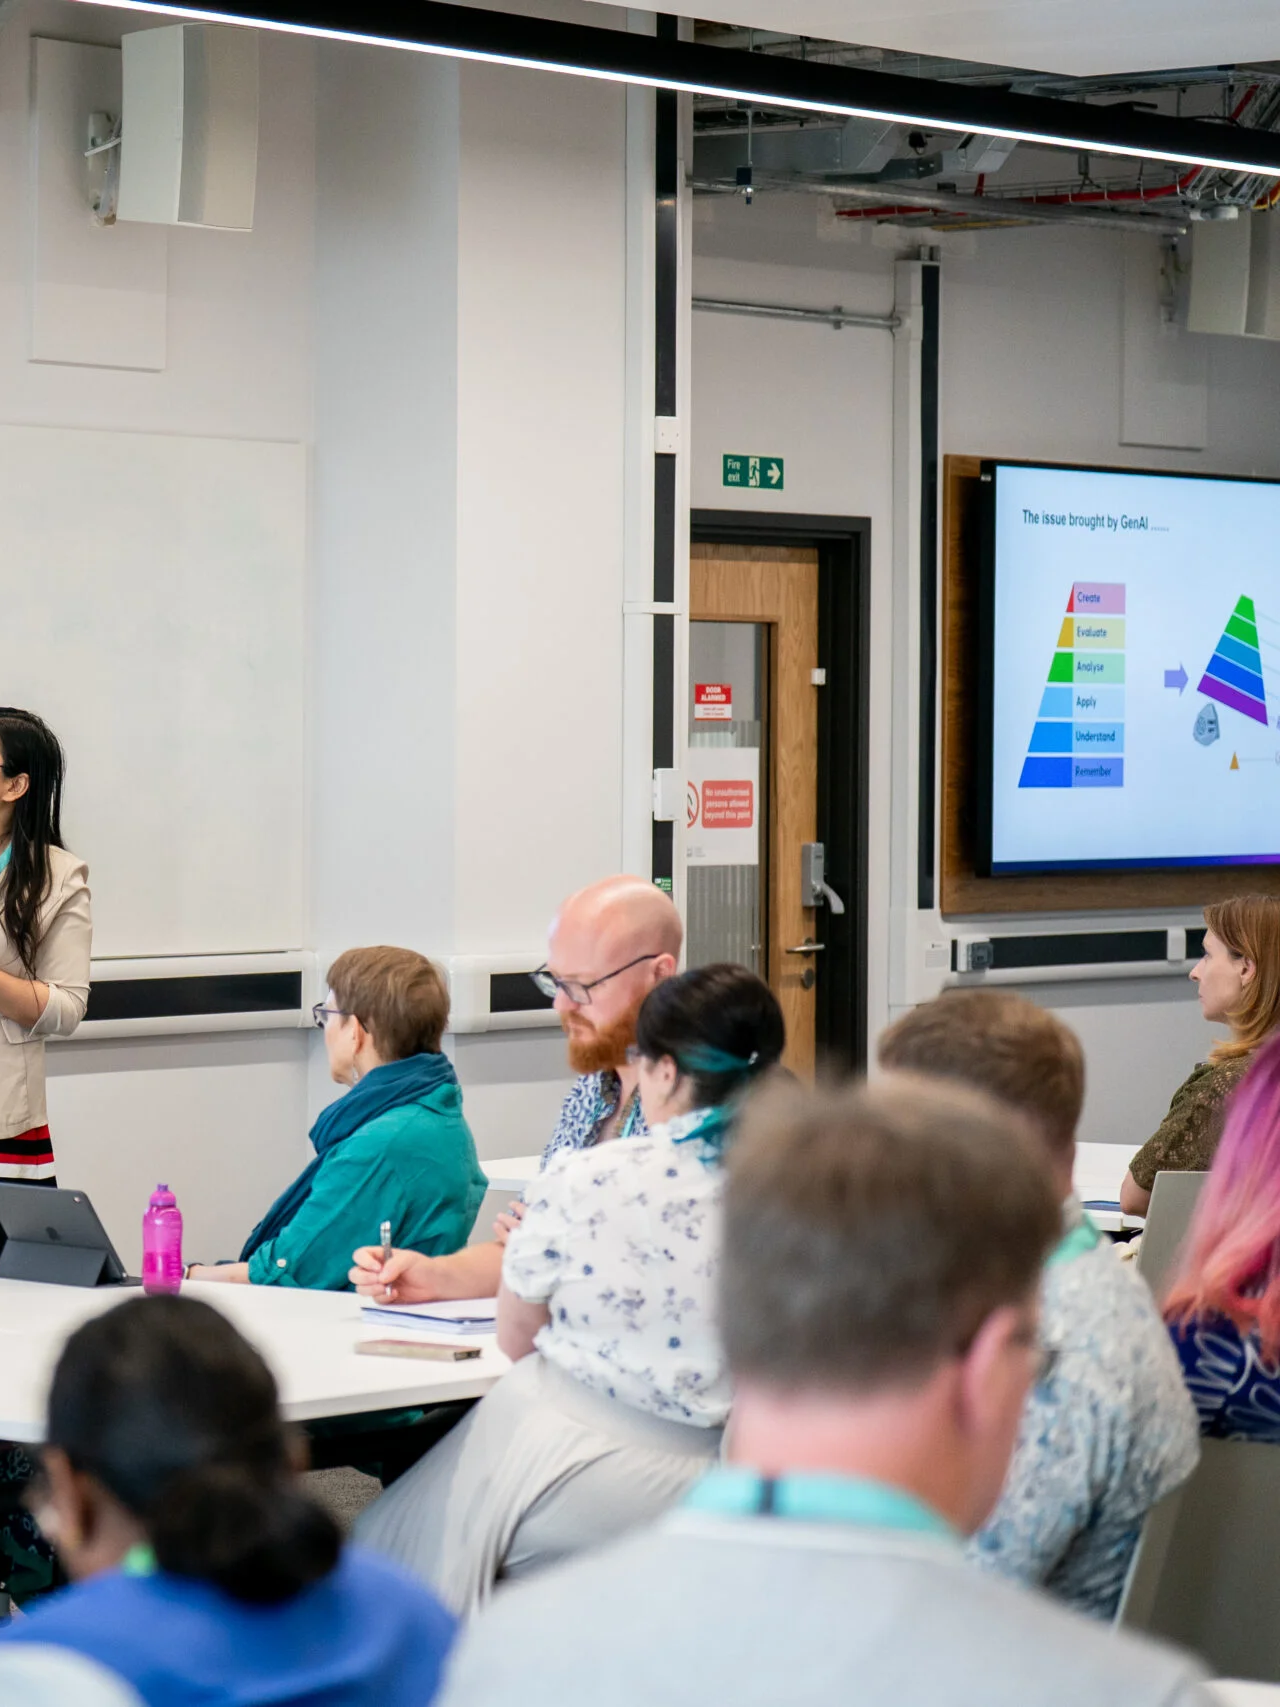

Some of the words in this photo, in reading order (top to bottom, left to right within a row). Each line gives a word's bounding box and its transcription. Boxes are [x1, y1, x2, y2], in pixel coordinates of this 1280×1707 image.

[727, 458, 741, 470] Fire
[727, 472, 740, 482] exit
[1022, 508, 1040, 524] The
[1042, 510, 1066, 526] issue
[1069, 512, 1105, 531] brought
[1107, 514, 1118, 532] by
[1120, 514, 1149, 530] GenAI
[1077, 591, 1101, 603] Create
[1076, 626, 1107, 638] Evaluate
[1076, 660, 1104, 674] Analyse
[1076, 695, 1097, 710] Apply
[1075, 730, 1116, 742] Understand
[1075, 764, 1112, 777] Remember
